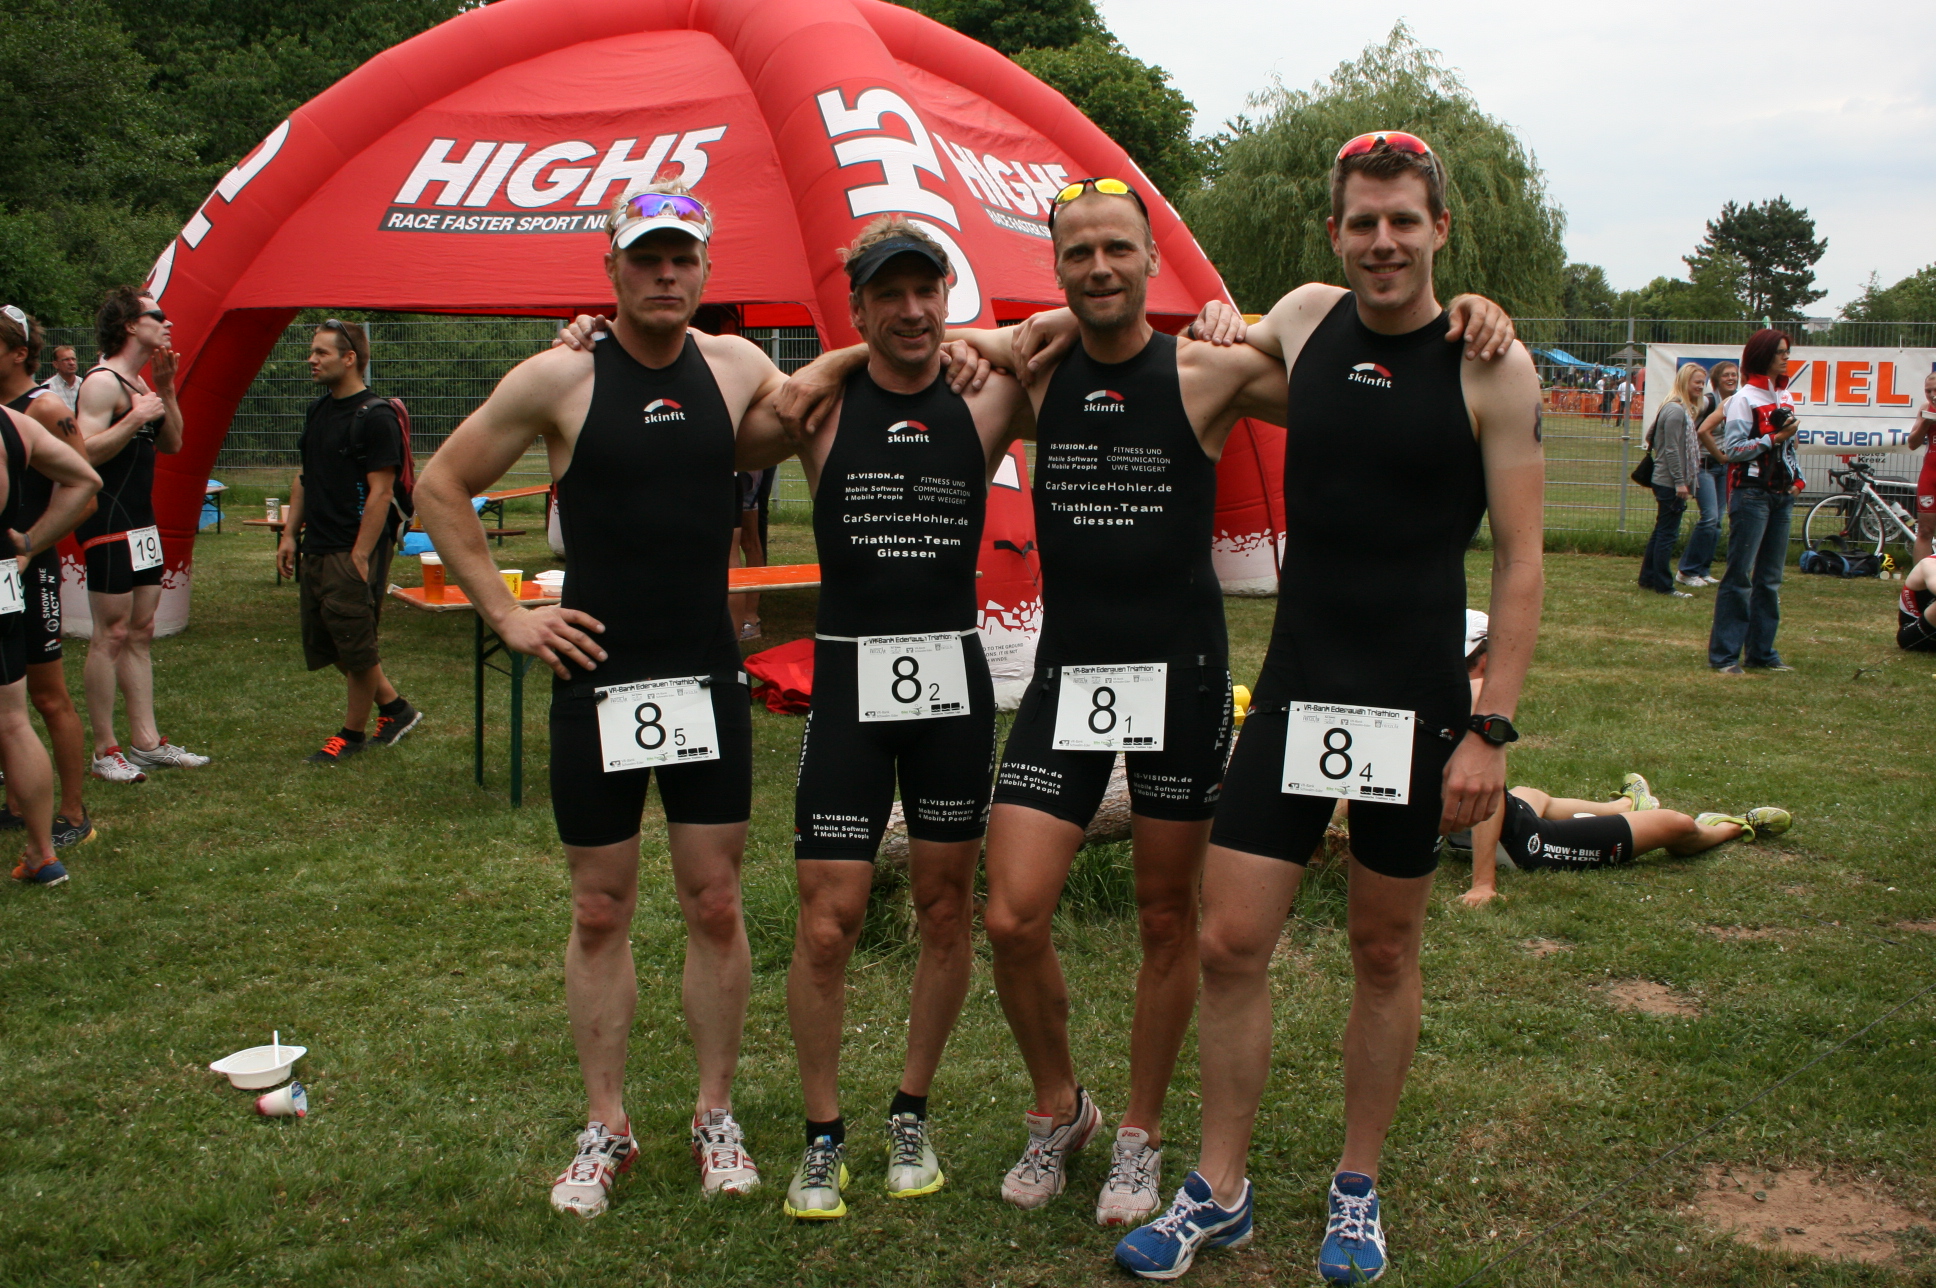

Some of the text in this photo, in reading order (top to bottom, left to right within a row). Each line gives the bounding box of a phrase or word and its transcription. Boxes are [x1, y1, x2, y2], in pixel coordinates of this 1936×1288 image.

[391, 124, 730, 208] HIGH5
[387, 213, 437, 229] RACE
[440, 214, 513, 231] FASTER
[516, 215, 583, 231] SPORT
[1347, 372, 1392, 389] skinfit
[1083, 403, 1125, 412] skinfit
[644, 411, 686, 424] skinfit
[887, 433, 930, 443] skinfit
[1797, 429, 1883, 446] erauen
[1050, 443, 1098, 451] IS-VISION.de
[1113, 446, 1144, 454] FITNESS
[1106, 456, 1171, 464] COMMUNICATION
[847, 472, 904, 480] IS-VISION.de
[920, 476, 966, 488] FITNESS UND
[1045, 481, 1172, 492] CarServiceHohler.de
[913, 486, 971, 497] COMMUNICATION
[918, 494, 966, 505] UWE WEIGERT
[1051, 502, 1164, 513] Triathlon-Team
[843, 512, 969, 526] CarServiceHohler.de
[1073, 516, 1134, 526] Giessen
[850, 535, 961, 546] Triathlon-Team
[136, 536, 157, 562] 19
[877, 548, 936, 558] Giessen
[42, 591, 51, 618] SNOW
[891, 656, 922, 704] 8
[608, 684, 635, 694] VR-Bank
[636, 681, 668, 690] Ederauen
[928, 682, 940, 702] 2
[1088, 686, 1116, 734] 8
[1304, 704, 1330, 712] VR-Bank
[1367, 708, 1400, 718] Triathlon
[634, 702, 666, 750] 8
[1124, 715, 1132, 734] 1
[674, 728, 686, 746] 5
[1319, 727, 1352, 780] 8
[1359, 762, 1373, 782] 4
[1003, 779, 1027, 788] Mobile
[1030, 783, 1060, 796] People
[1023, 775, 1062, 789] Software
[1154, 785, 1191, 793] Software
[1160, 792, 1190, 800] People
[919, 798, 976, 806] IS-VISION.de
[918, 807, 974, 816] Mobile Software
[812, 813, 869, 823] IS-VISION.de
[922, 814, 946, 822] Mobile
[813, 824, 839, 832] Mobile
[848, 832, 870, 840] People
[1542, 843, 1571, 855] SNOW
[1578, 848, 1602, 857] BIKE
[1542, 852, 1600, 862] ACTION
